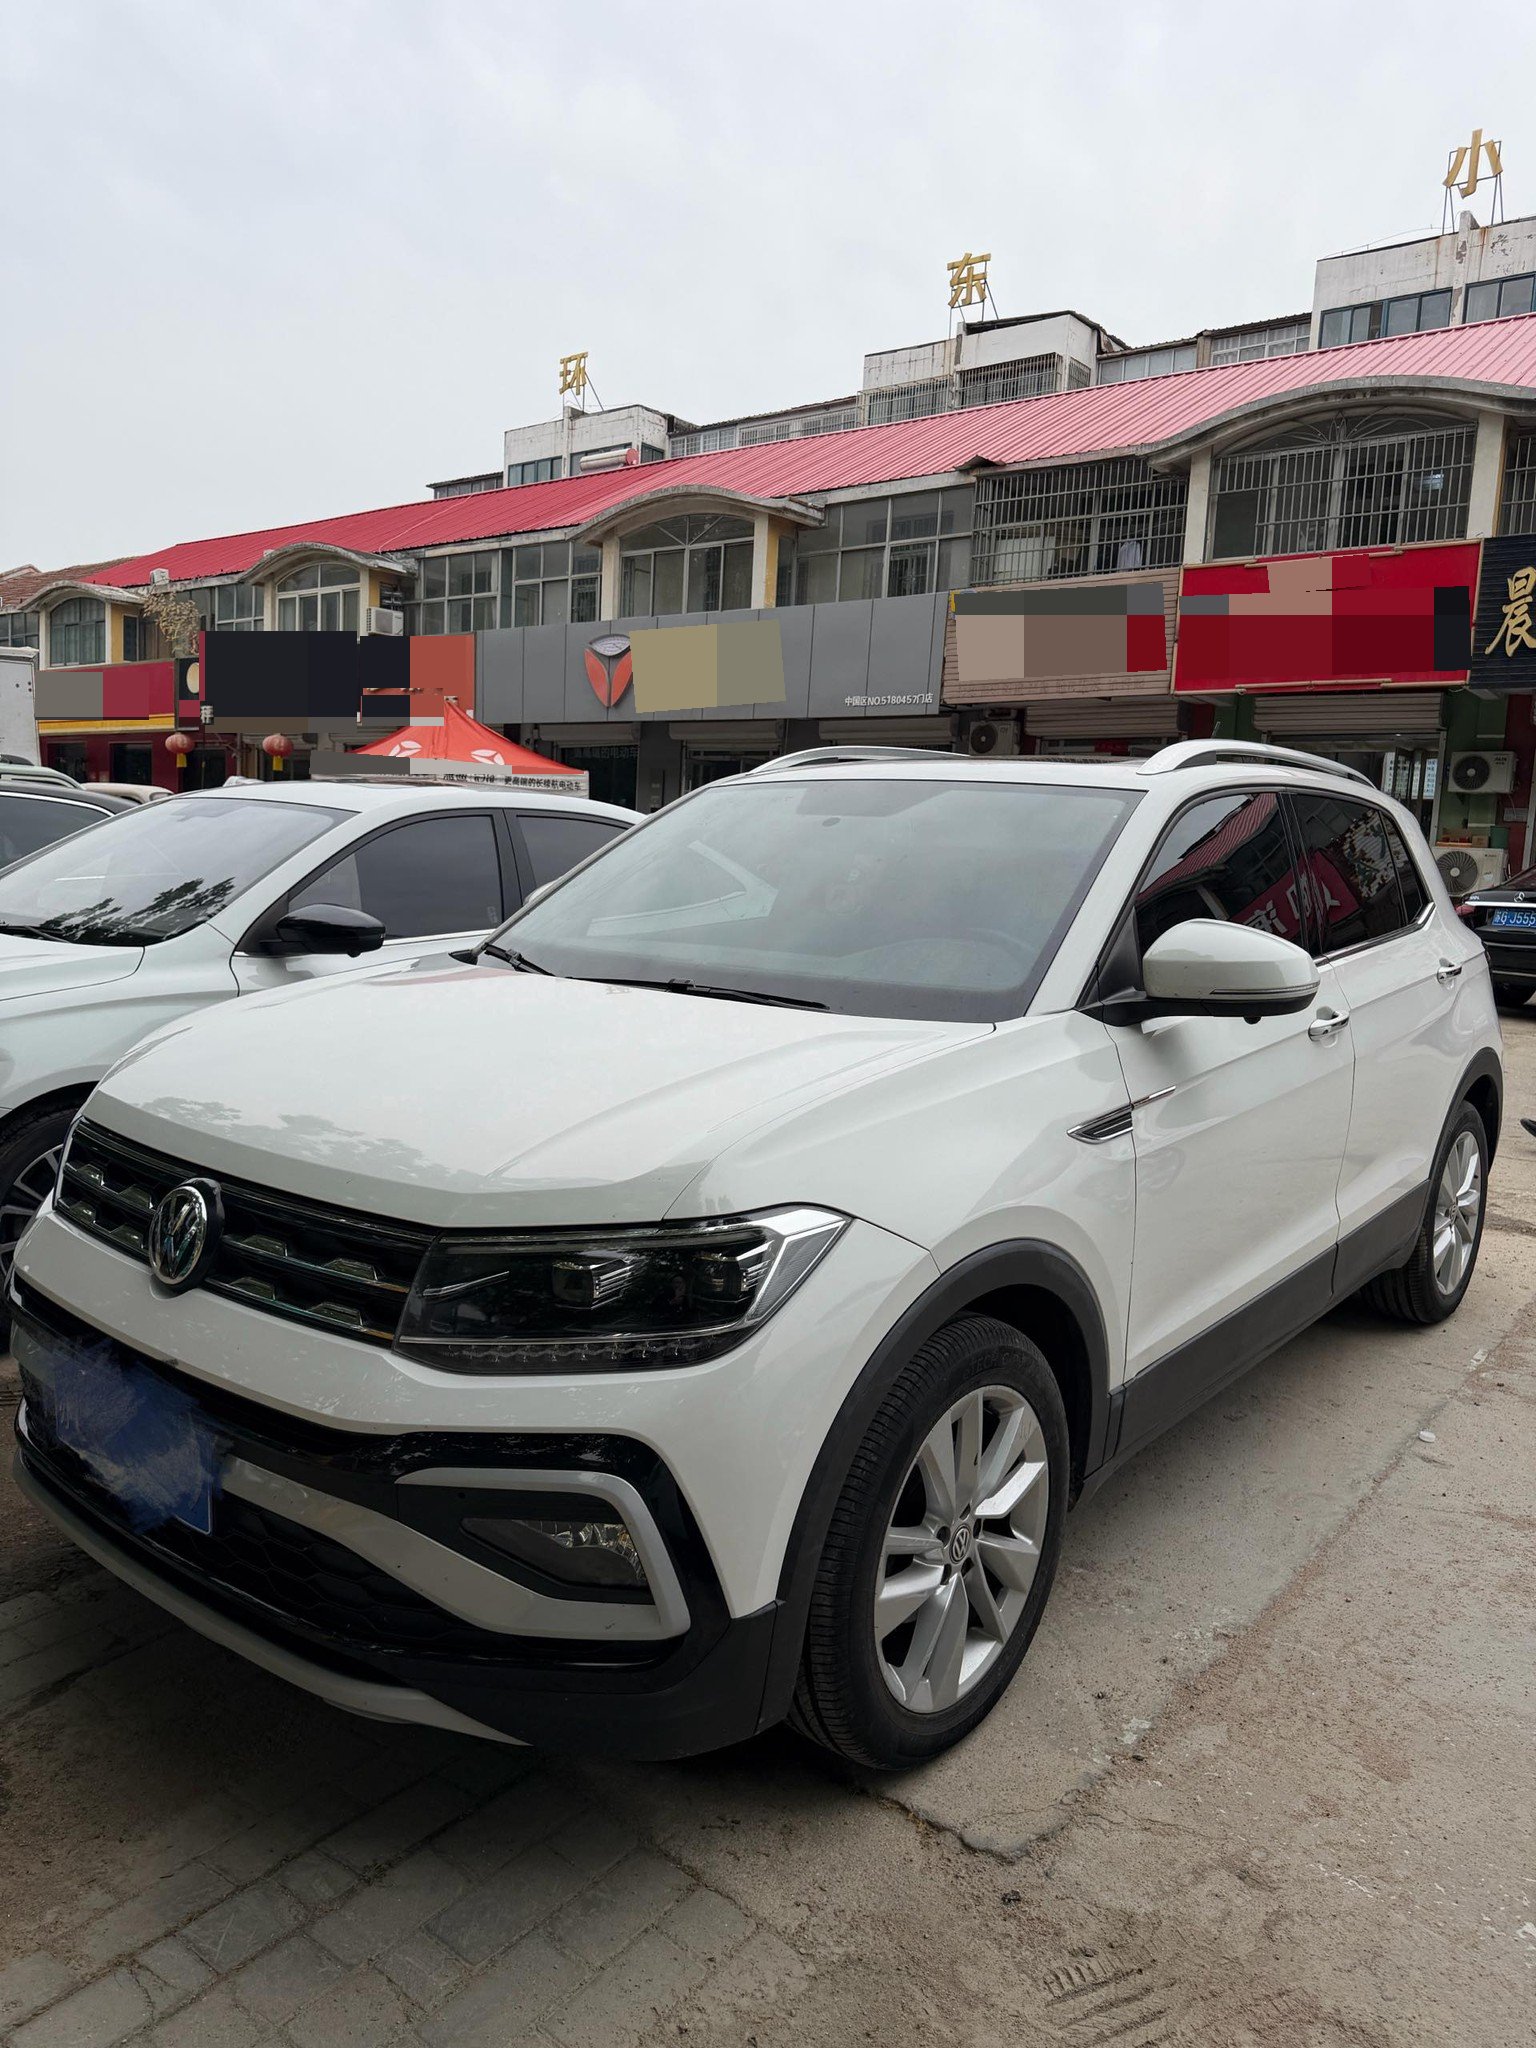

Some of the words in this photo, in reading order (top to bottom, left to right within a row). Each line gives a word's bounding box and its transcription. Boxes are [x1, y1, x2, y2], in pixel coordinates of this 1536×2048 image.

[947, 252, 992, 308] 东
[1442, 128, 1504, 200] 小
[1484, 566, 1536, 657] 晨
